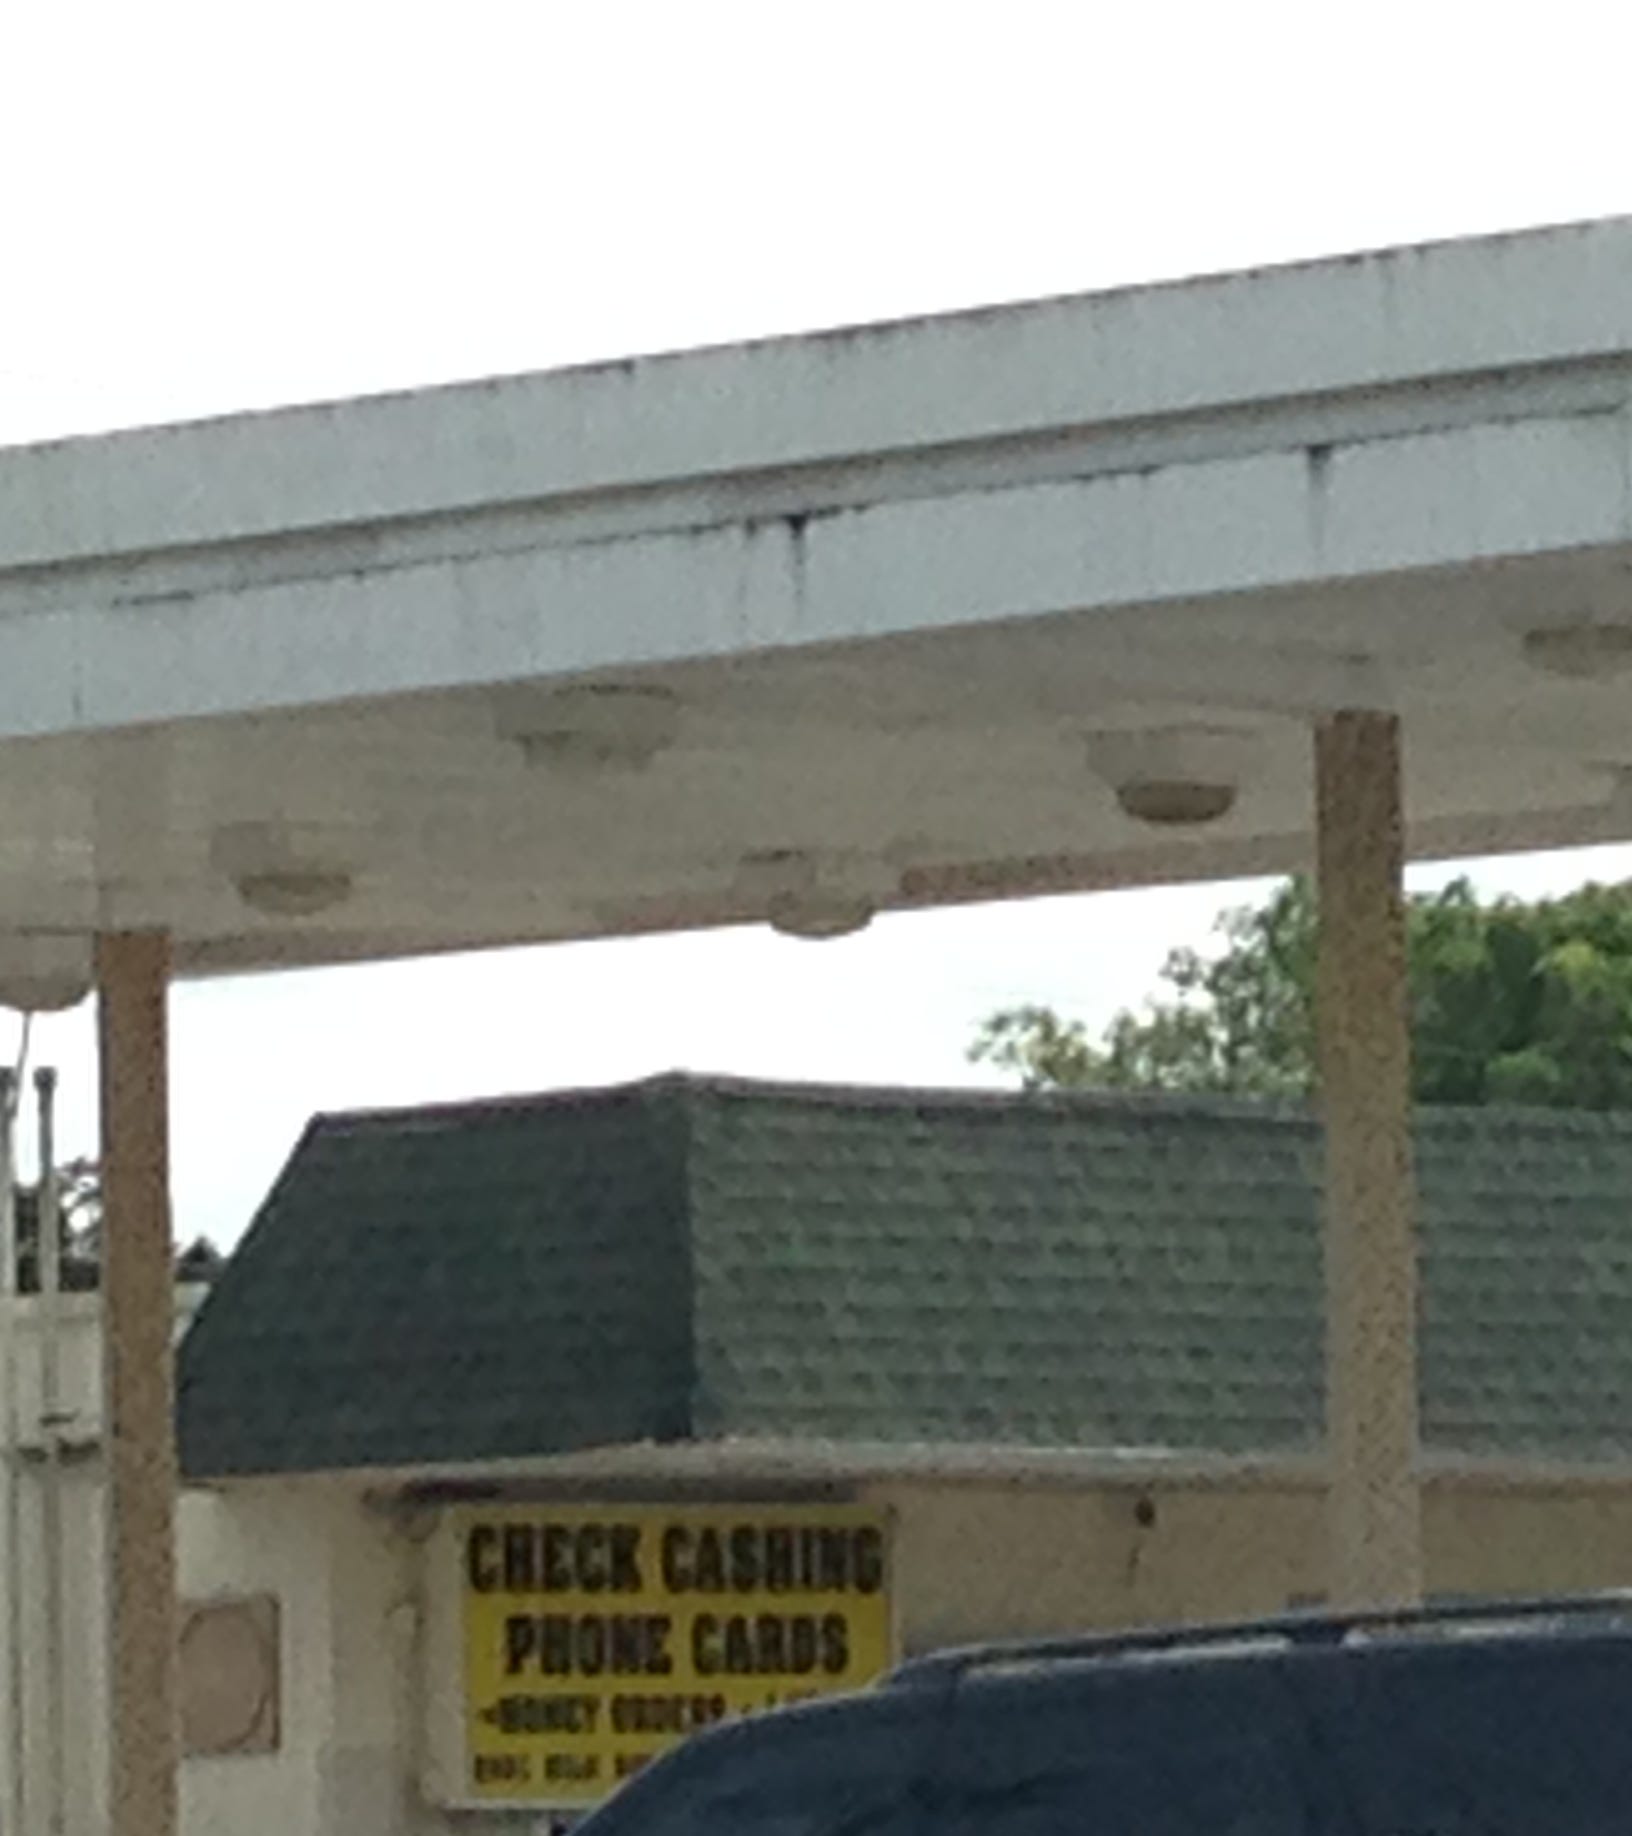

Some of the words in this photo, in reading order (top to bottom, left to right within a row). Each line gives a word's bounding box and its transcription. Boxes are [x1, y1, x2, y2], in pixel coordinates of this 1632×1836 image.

[467, 1523, 643, 1594] CHECK
[659, 1523, 885, 1594] CASHING
[505, 1612, 673, 1676] PHONE
[690, 1612, 850, 1675] CARDS
